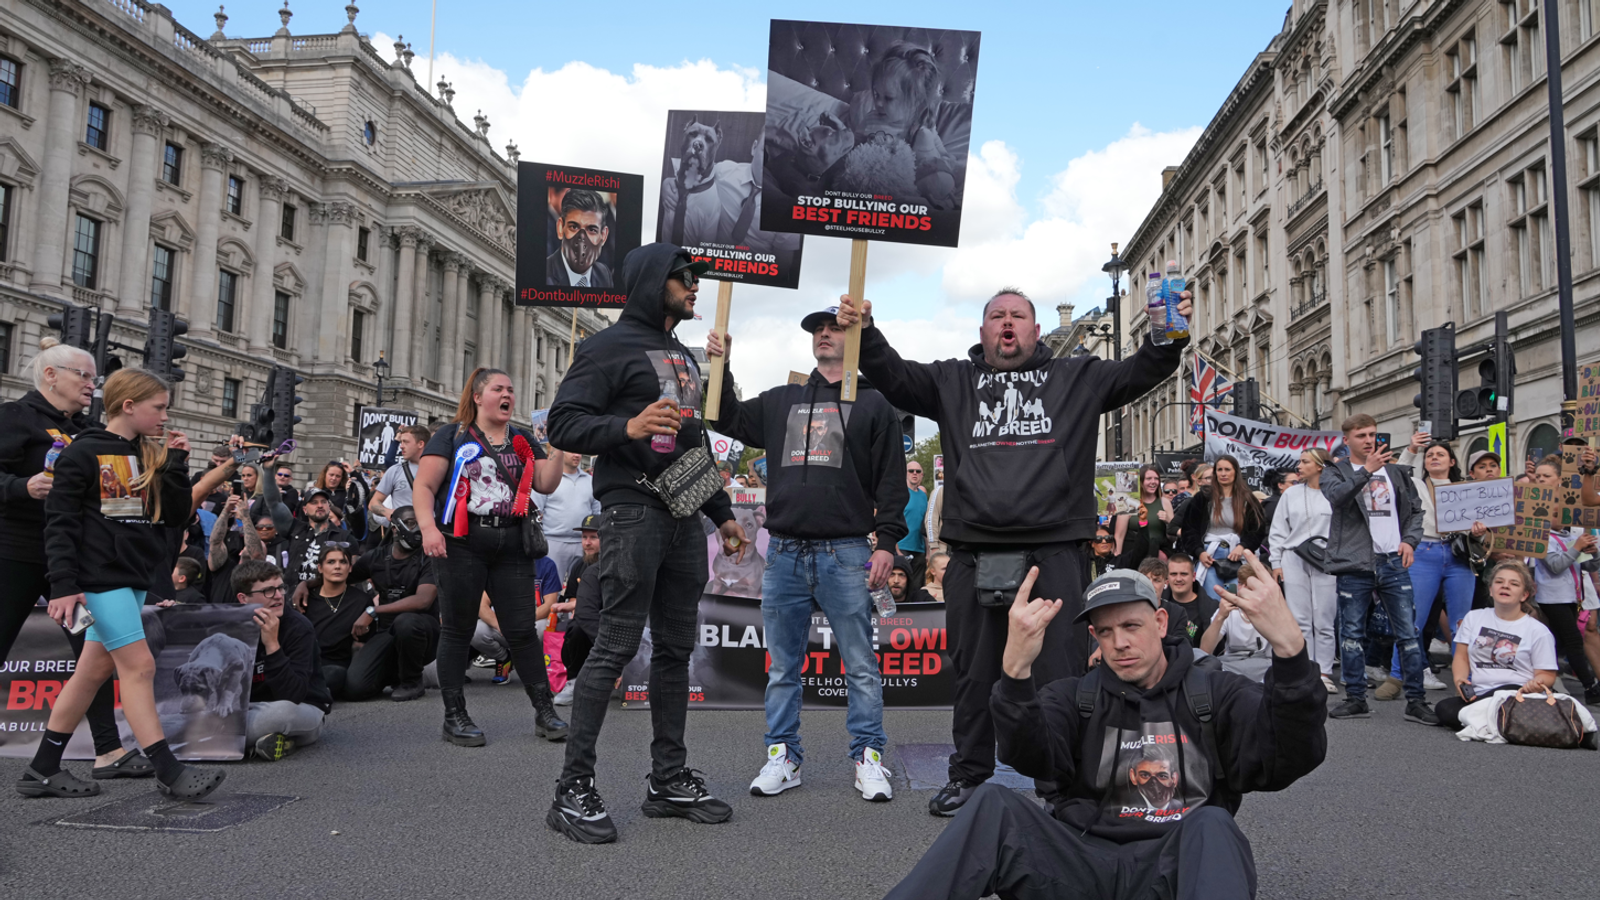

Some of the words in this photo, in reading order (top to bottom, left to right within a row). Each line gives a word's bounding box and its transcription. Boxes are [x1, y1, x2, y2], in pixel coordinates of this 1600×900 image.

[545, 170, 620, 189] #MuzzleRishi
[841, 191, 859, 199] BULLY
[797, 195, 831, 208] STOP
[834, 197, 897, 213] BULLYING
[899, 203, 928, 216] OUR
[792, 205, 842, 224] BEST
[846, 209, 932, 231] FRIENDS
[824, 224, 886, 235] @STEELHOUSEBULLYZ
[706, 248, 753, 261] BULLYING
[754, 253, 776, 264] OUR
[714, 258, 779, 276] FRIENDS
[520, 287, 627, 305] #Dontbullymybree
[1010, 369, 1048, 388] BULLY
[1584, 366, 1600, 379] DO
[1584, 403, 1600, 415] OU
[362, 412, 388, 429] DONT
[389, 414, 416, 427] BULLY
[972, 420, 996, 438] MY
[998, 417, 1052, 437] BREED
[1576, 417, 1600, 433] BRE
[1206, 415, 1276, 447] DON'T
[1273, 432, 1338, 453] BULLY
[360, 450, 376, 464] MY
[736, 493, 757, 502] BULLY
[1440, 488, 1472, 503] DONT
[1476, 485, 1511, 499] BULLY
[1514, 486, 1553, 501] NISH
[1443, 508, 1472, 523] OUR
[1473, 502, 1511, 520] BREED
[1561, 507, 1600, 526] BRE
[1516, 515, 1551, 529] DEED
[1523, 527, 1550, 541] THE
[1494, 537, 1546, 554] BREED
[880, 618, 913, 626] BREED
[699, 624, 768, 649] BLA
[817, 627, 879, 650] TE
[889, 628, 947, 651] OW
[34, 660, 77, 673] BREE
[627, 684, 648, 692] STOP
[818, 688, 848, 697] COVE
[1121, 806, 1154, 815] DONT
[1155, 807, 1190, 817] BULLY
[1145, 812, 1182, 823] BREED
